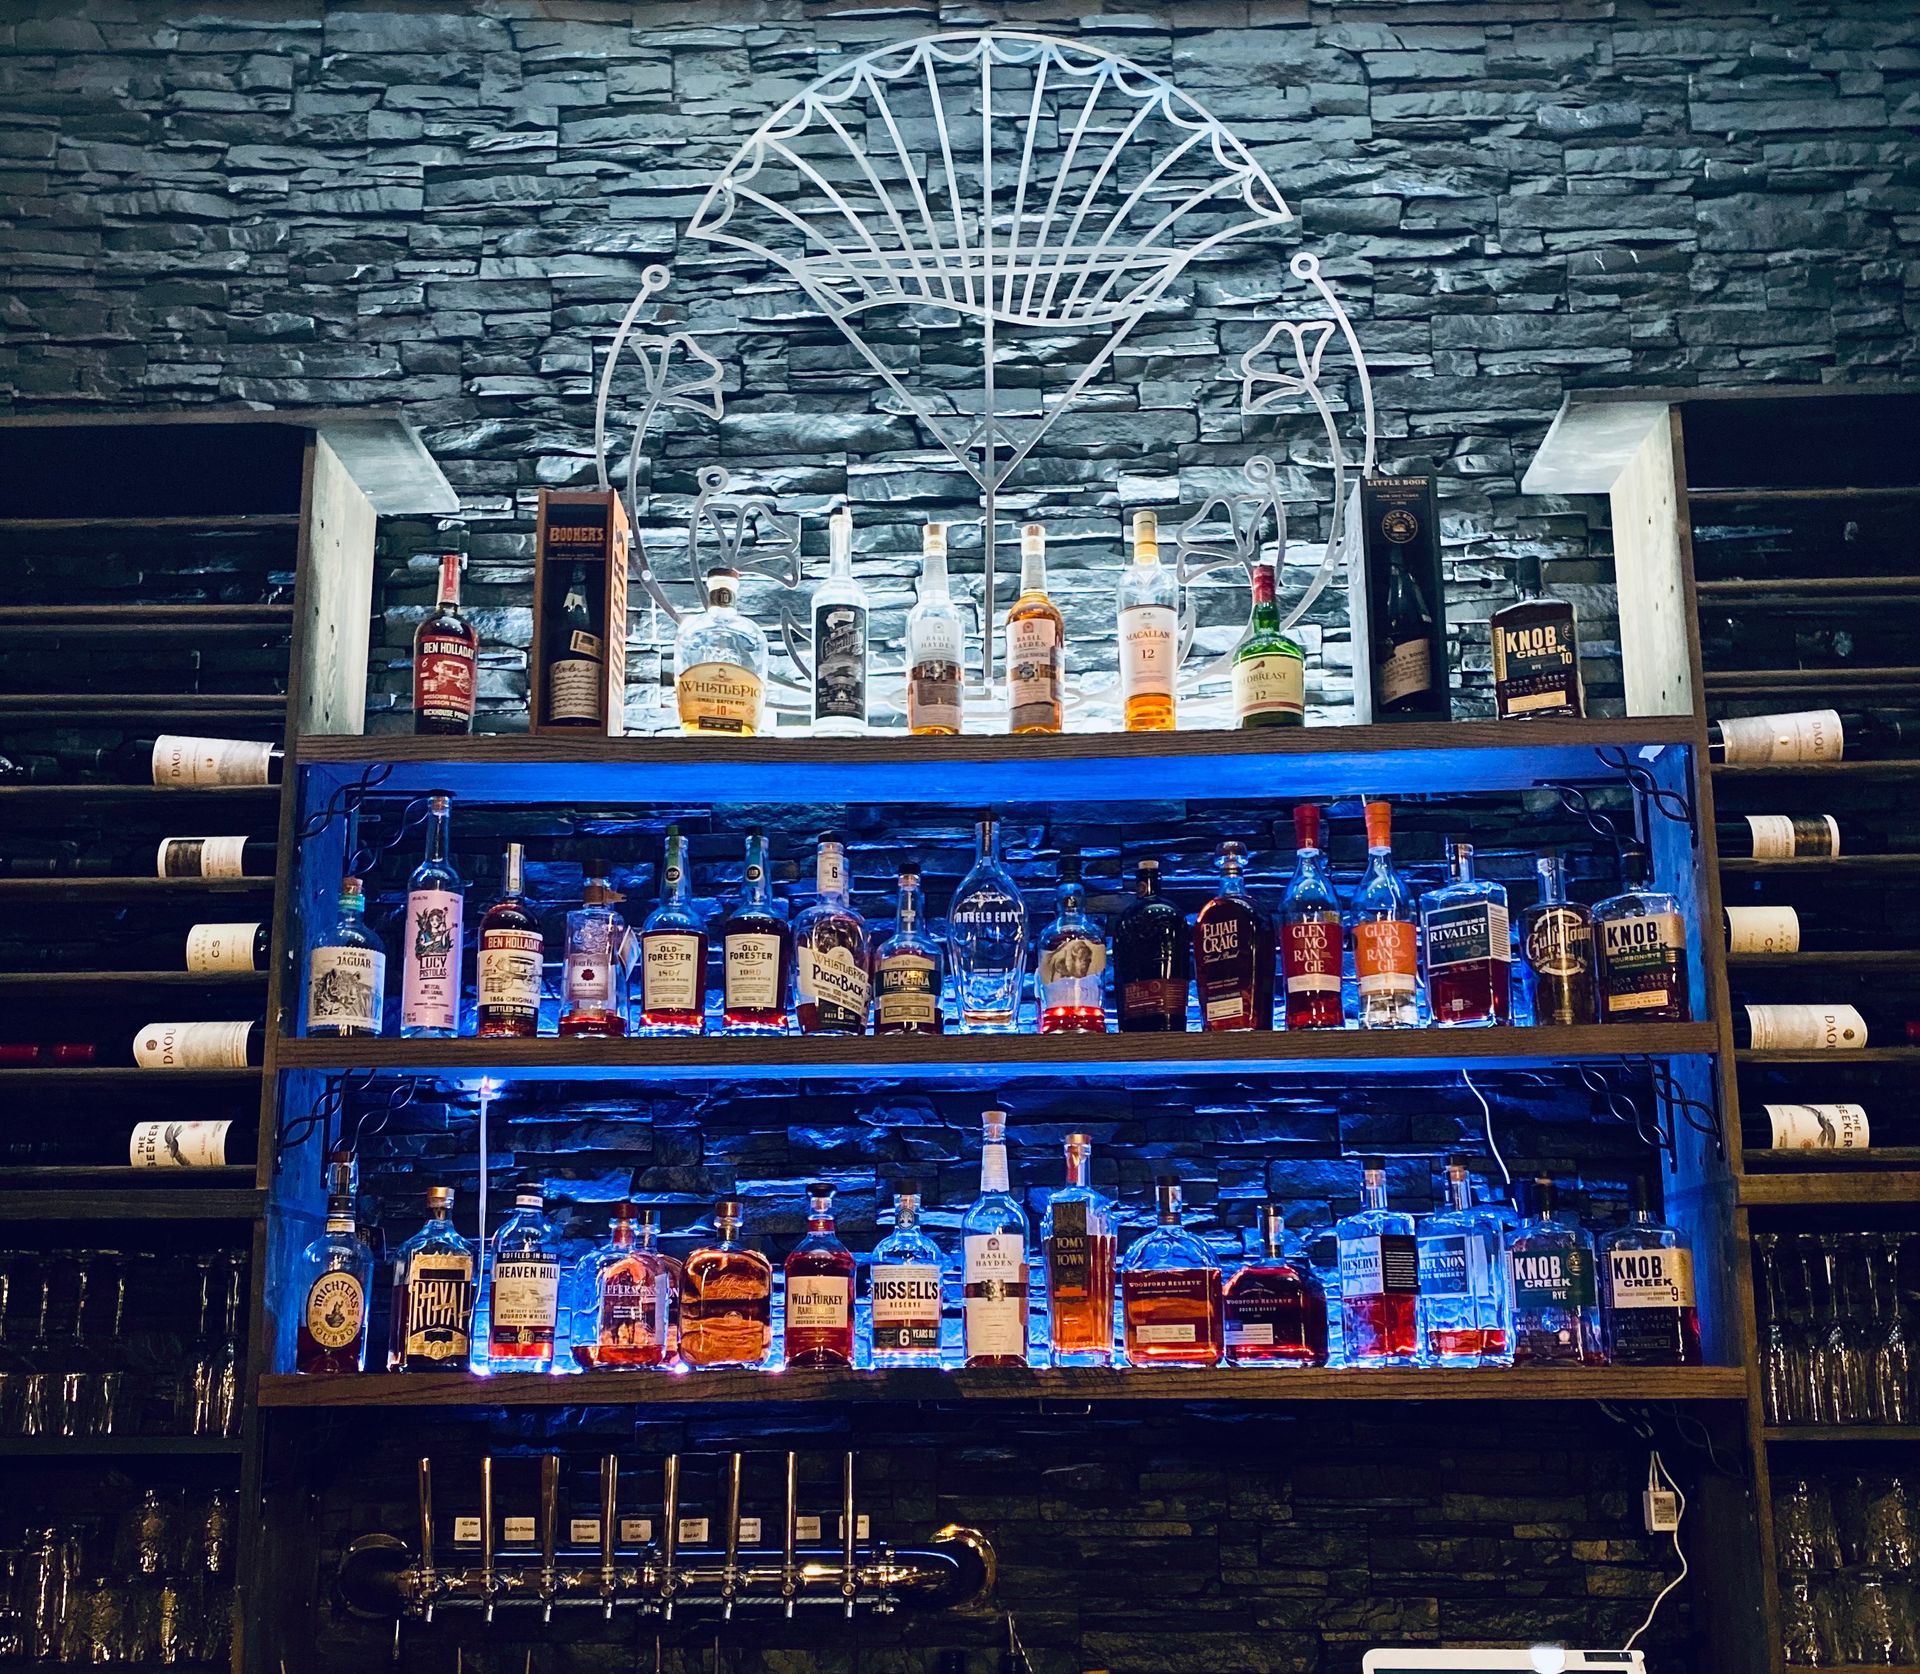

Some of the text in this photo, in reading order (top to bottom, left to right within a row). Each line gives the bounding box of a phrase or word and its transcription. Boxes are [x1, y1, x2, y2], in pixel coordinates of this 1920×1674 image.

[1126, 630, 1171, 641] MACALLAN
[1506, 625, 1556, 653] KNOB
[423, 642, 475, 659] BEN HOLLADAY
[1142, 649, 1154, 659] 12
[1516, 644, 1567, 659] CREEK
[422, 658, 428, 668] 6
[1560, 652, 1572, 665] 10
[680, 680, 763, 698] WHISTLEPIG
[1255, 691, 1266, 700] 12
[716, 706, 727, 715] 10
[1812, 722, 1824, 754] DAOU
[832, 867, 837, 878] 6
[1202, 920, 1238, 939] ELIJAH
[1292, 925, 1326, 938] GLEN
[1365, 925, 1399, 937] GLEN
[1430, 923, 1487, 943] RIVALIST
[1608, 922, 1658, 947] KNOB
[212, 939, 220, 958] CS
[488, 936, 540, 950] BEN HOLLADAY
[1203, 934, 1238, 953] CRAIG
[1304, 937, 1327, 949] MO
[1377, 936, 1400, 948] MO
[1618, 942, 1668, 954] CREEK
[486, 955, 492, 965] 6
[648, 952, 691, 962] FORESTER
[729, 951, 773, 960] FORESTER
[1294, 950, 1320, 962] RAN
[1367, 948, 1393, 961] RAN
[337, 956, 371, 969] JAGUAR
[420, 956, 447, 969] LUCY
[1304, 960, 1325, 973] GIE
[1378, 960, 1398, 972] GIE
[419, 968, 447, 977] PISTOLAS
[812, 964, 864, 997] PIGGYBACK
[838, 1007, 844, 1019] 6
[163, 1028, 176, 1064] DAOU
[1851, 1114, 1861, 1131] THE
[138, 1136, 146, 1154] THE
[1057, 1254, 1084, 1266] TOWN
[1343, 1257, 1379, 1270] RESERVE
[1419, 1256, 1465, 1270] REUNION
[499, 1266, 558, 1279] HEAVEN HILL
[1515, 1256, 1561, 1280] KNOB
[1614, 1256, 1662, 1279] KNOB
[1524, 1278, 1571, 1288] CREEK
[1624, 1278, 1673, 1287] CREEK
[314, 1280, 359, 1308] MICHTER'S
[874, 1281, 938, 1299] RUSSELL'S
[1552, 1291, 1567, 1300] RYE
[1671, 1287, 1678, 1301] 9
[792, 1292, 843, 1305] WILD TURKEY
[413, 1281, 471, 1331] ROYAL
[311, 1320, 358, 1342] BOURBON
[900, 1330, 909, 1346] 6
[913, 1329, 928, 1338] YEARS
